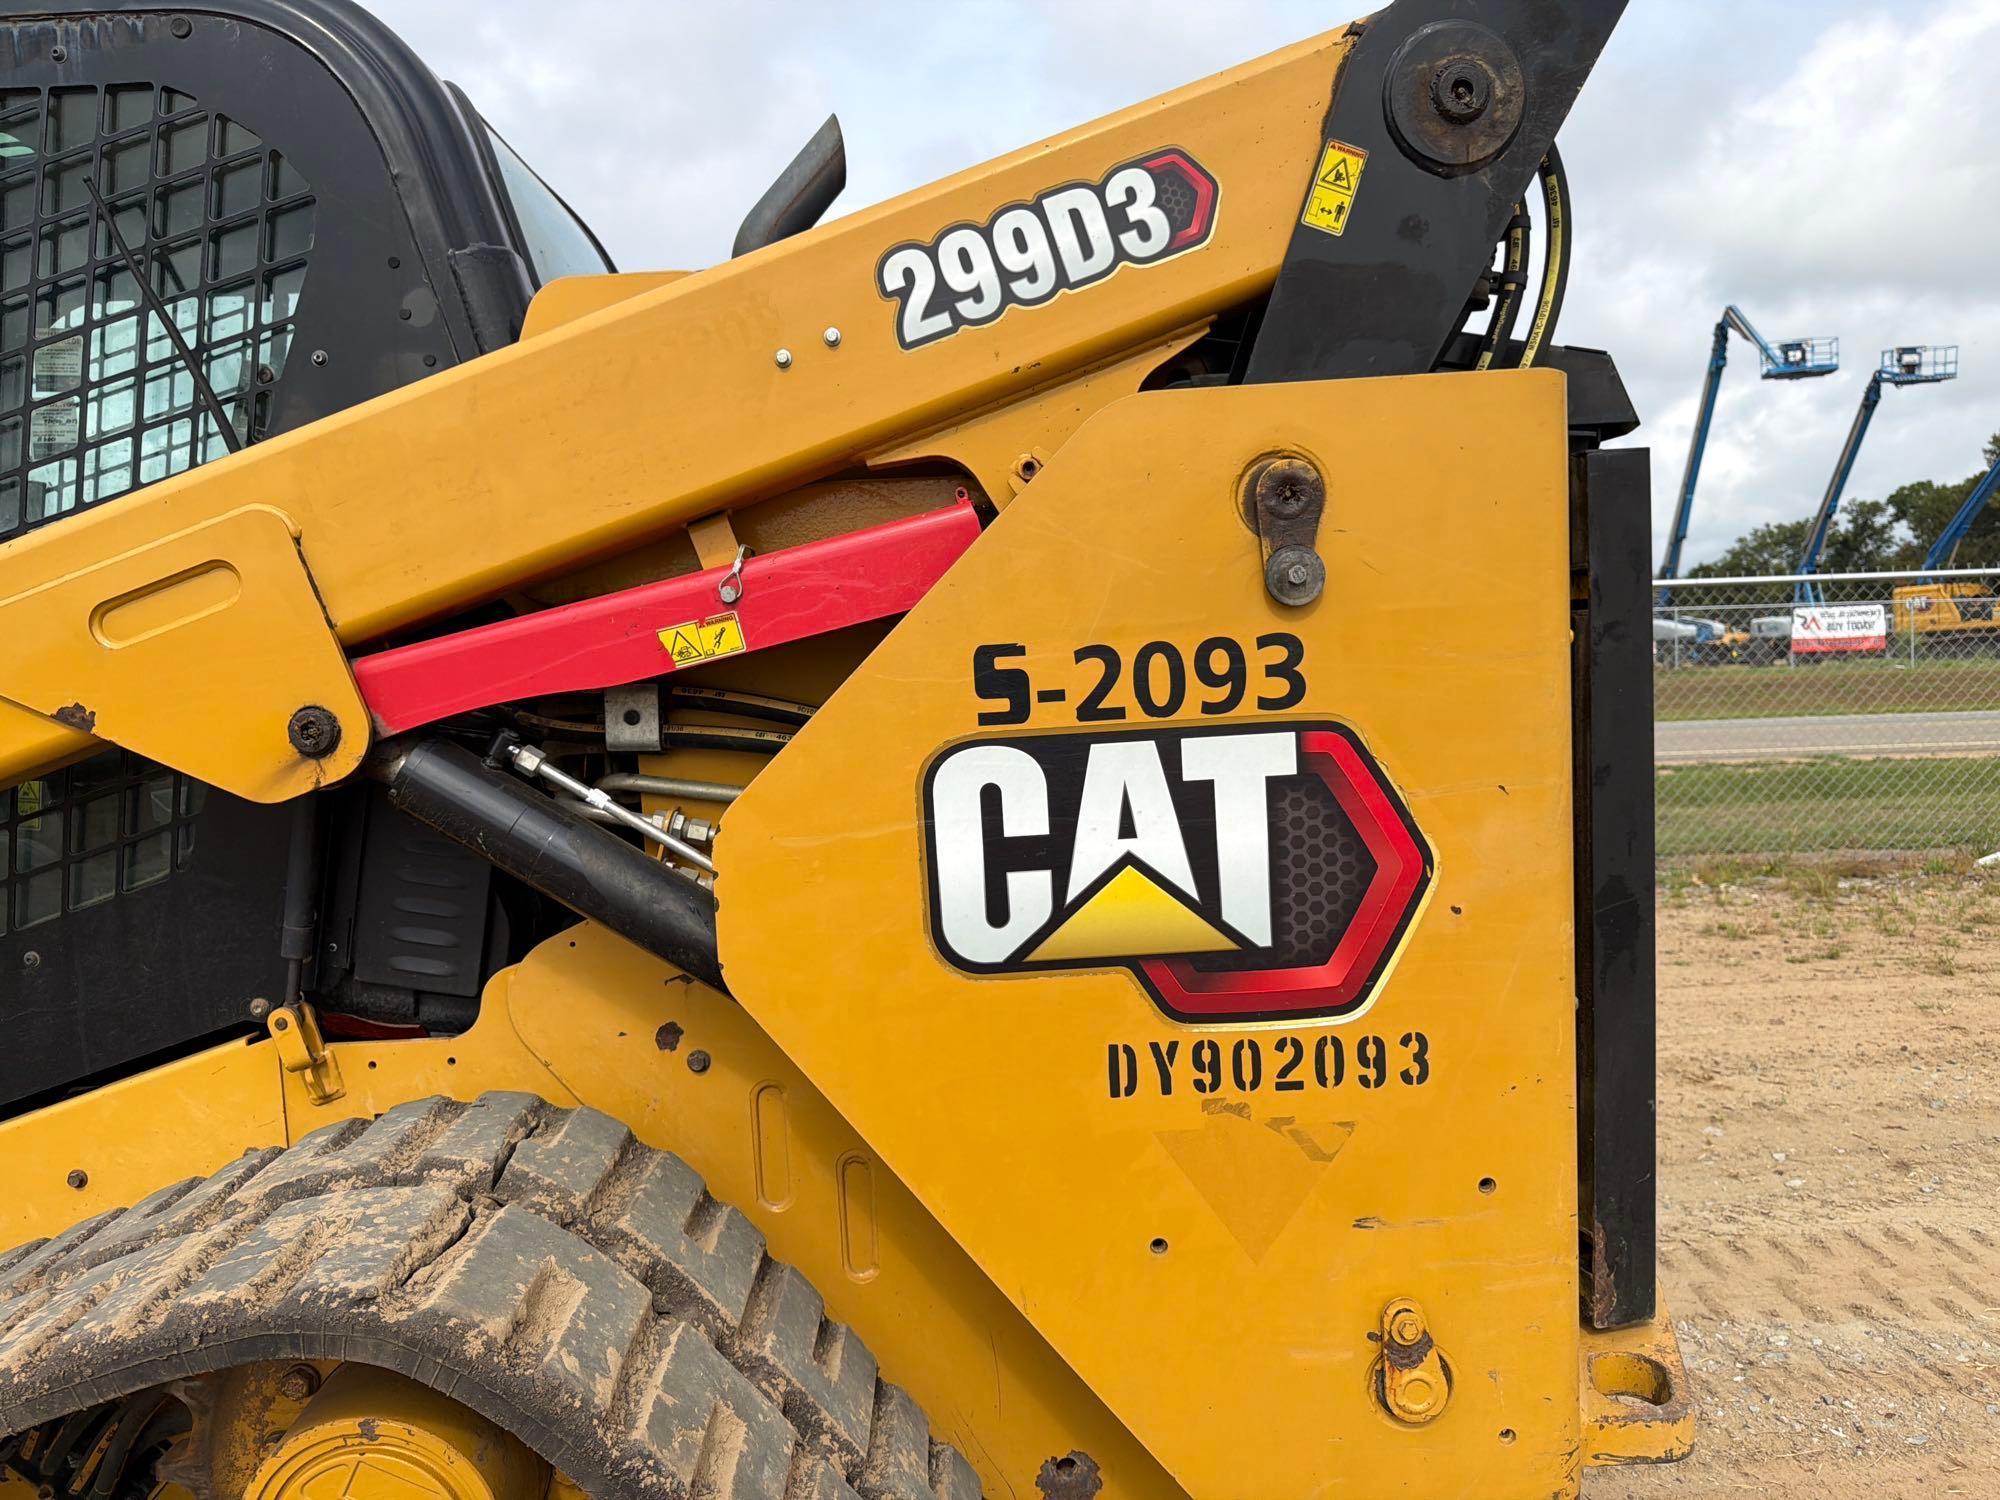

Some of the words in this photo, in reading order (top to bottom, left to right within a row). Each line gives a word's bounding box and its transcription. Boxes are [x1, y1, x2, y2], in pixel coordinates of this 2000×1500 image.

[1336, 144, 1365, 160] WARNING
[1548, 184, 1559, 207] 4636
[882, 167, 1171, 344] 299D3
[705, 614, 735, 627] WARNING
[971, 632, 1307, 727] S-2093
[932, 731, 1298, 964] CAT
[1108, 1031, 1430, 1099] DY902093
